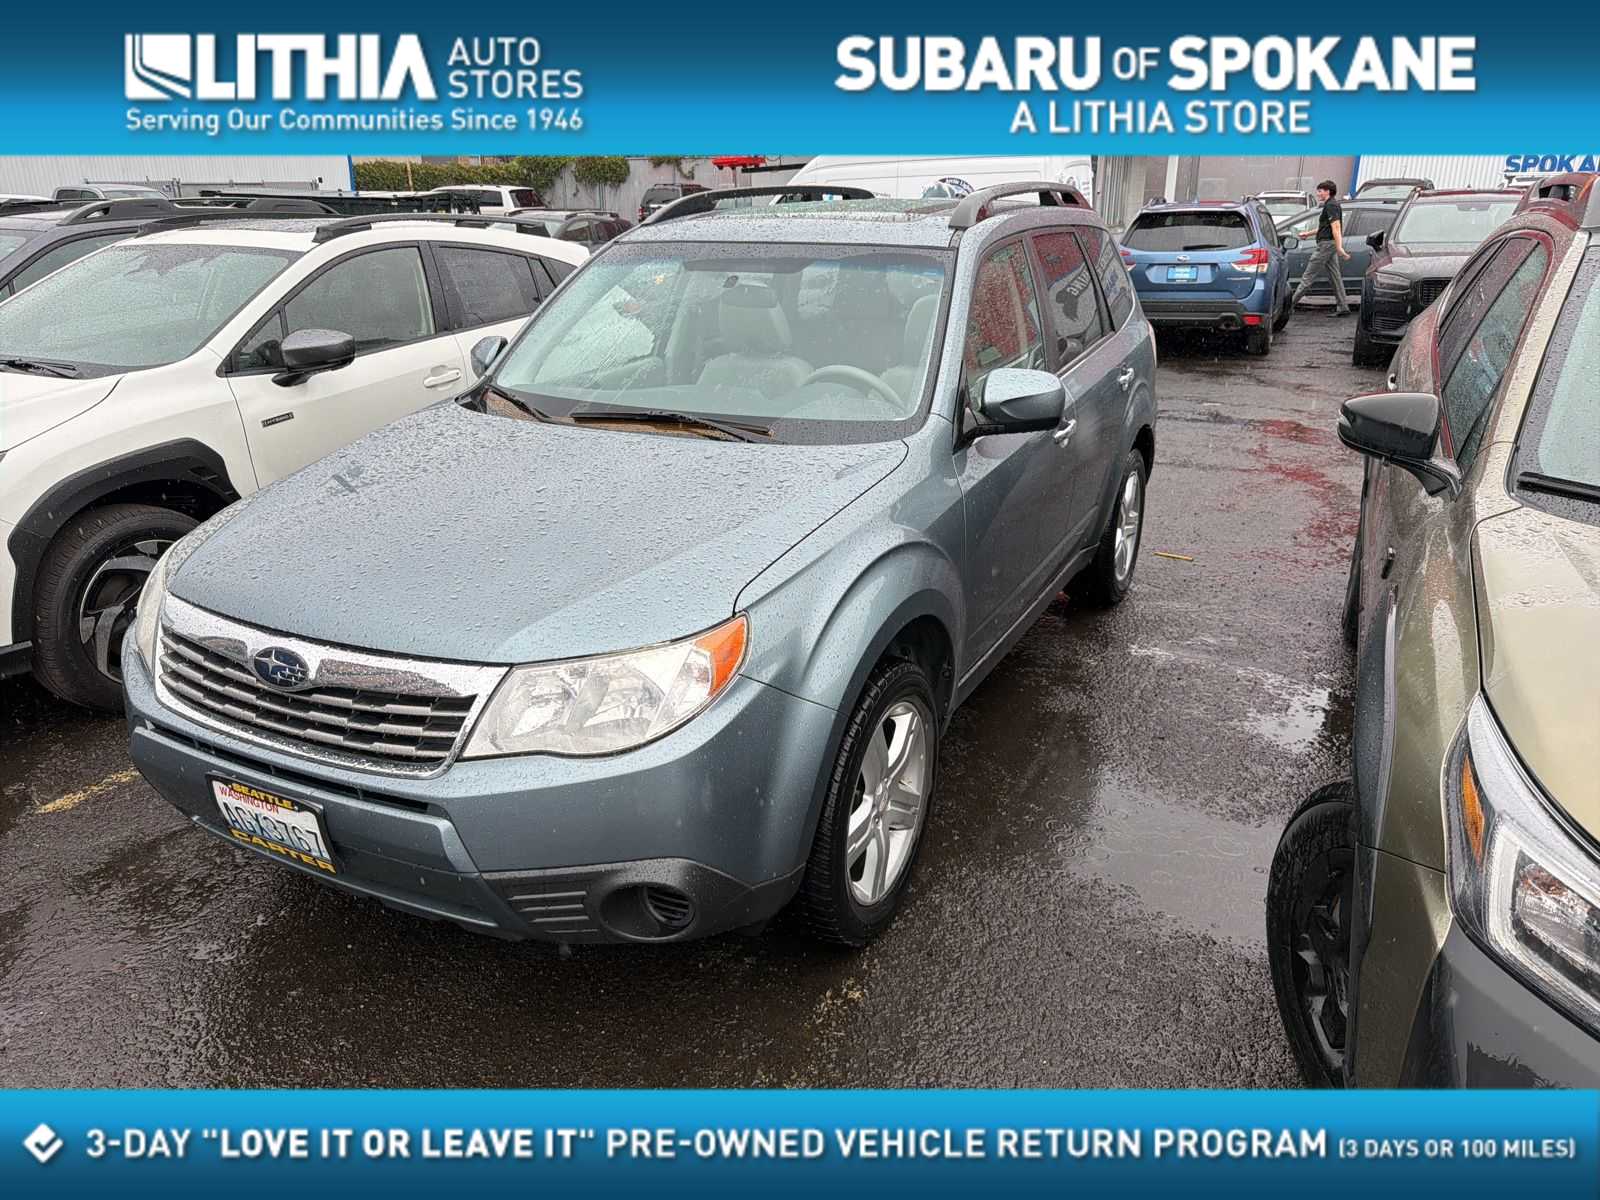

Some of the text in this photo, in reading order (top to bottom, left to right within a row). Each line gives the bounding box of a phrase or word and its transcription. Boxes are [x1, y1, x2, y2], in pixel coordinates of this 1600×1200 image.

[1506, 154, 1600, 173] SPOKA
[218, 786, 280, 815] WASHINGTON
[230, 829, 337, 874] CARTER
